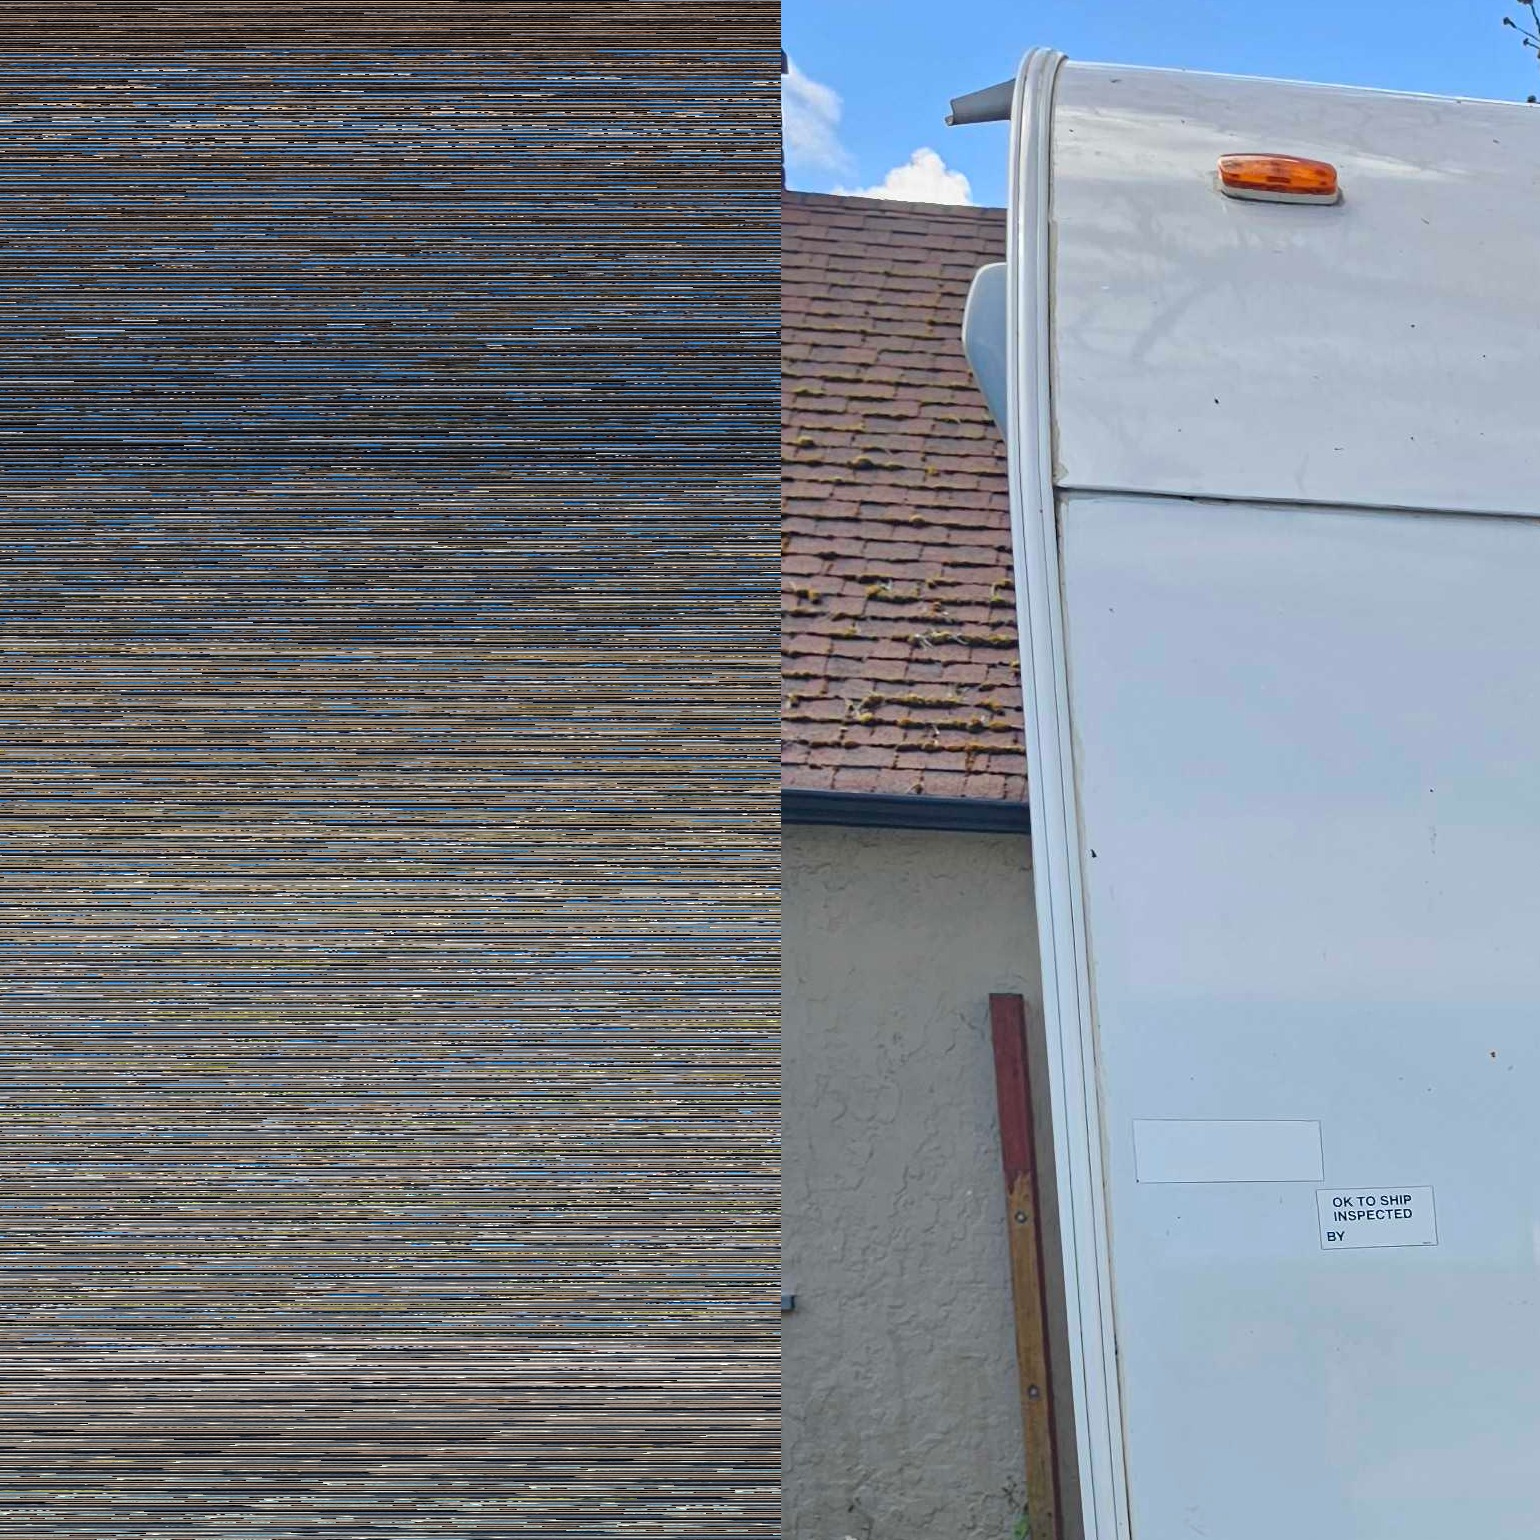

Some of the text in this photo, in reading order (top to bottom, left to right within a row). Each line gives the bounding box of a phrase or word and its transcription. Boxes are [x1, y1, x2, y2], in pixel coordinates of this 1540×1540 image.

[1332, 1194, 1412, 1208] OK TO SHIP
[1333, 1208, 1413, 1221] INSPECTED
[1327, 1230, 1345, 1242] BY
